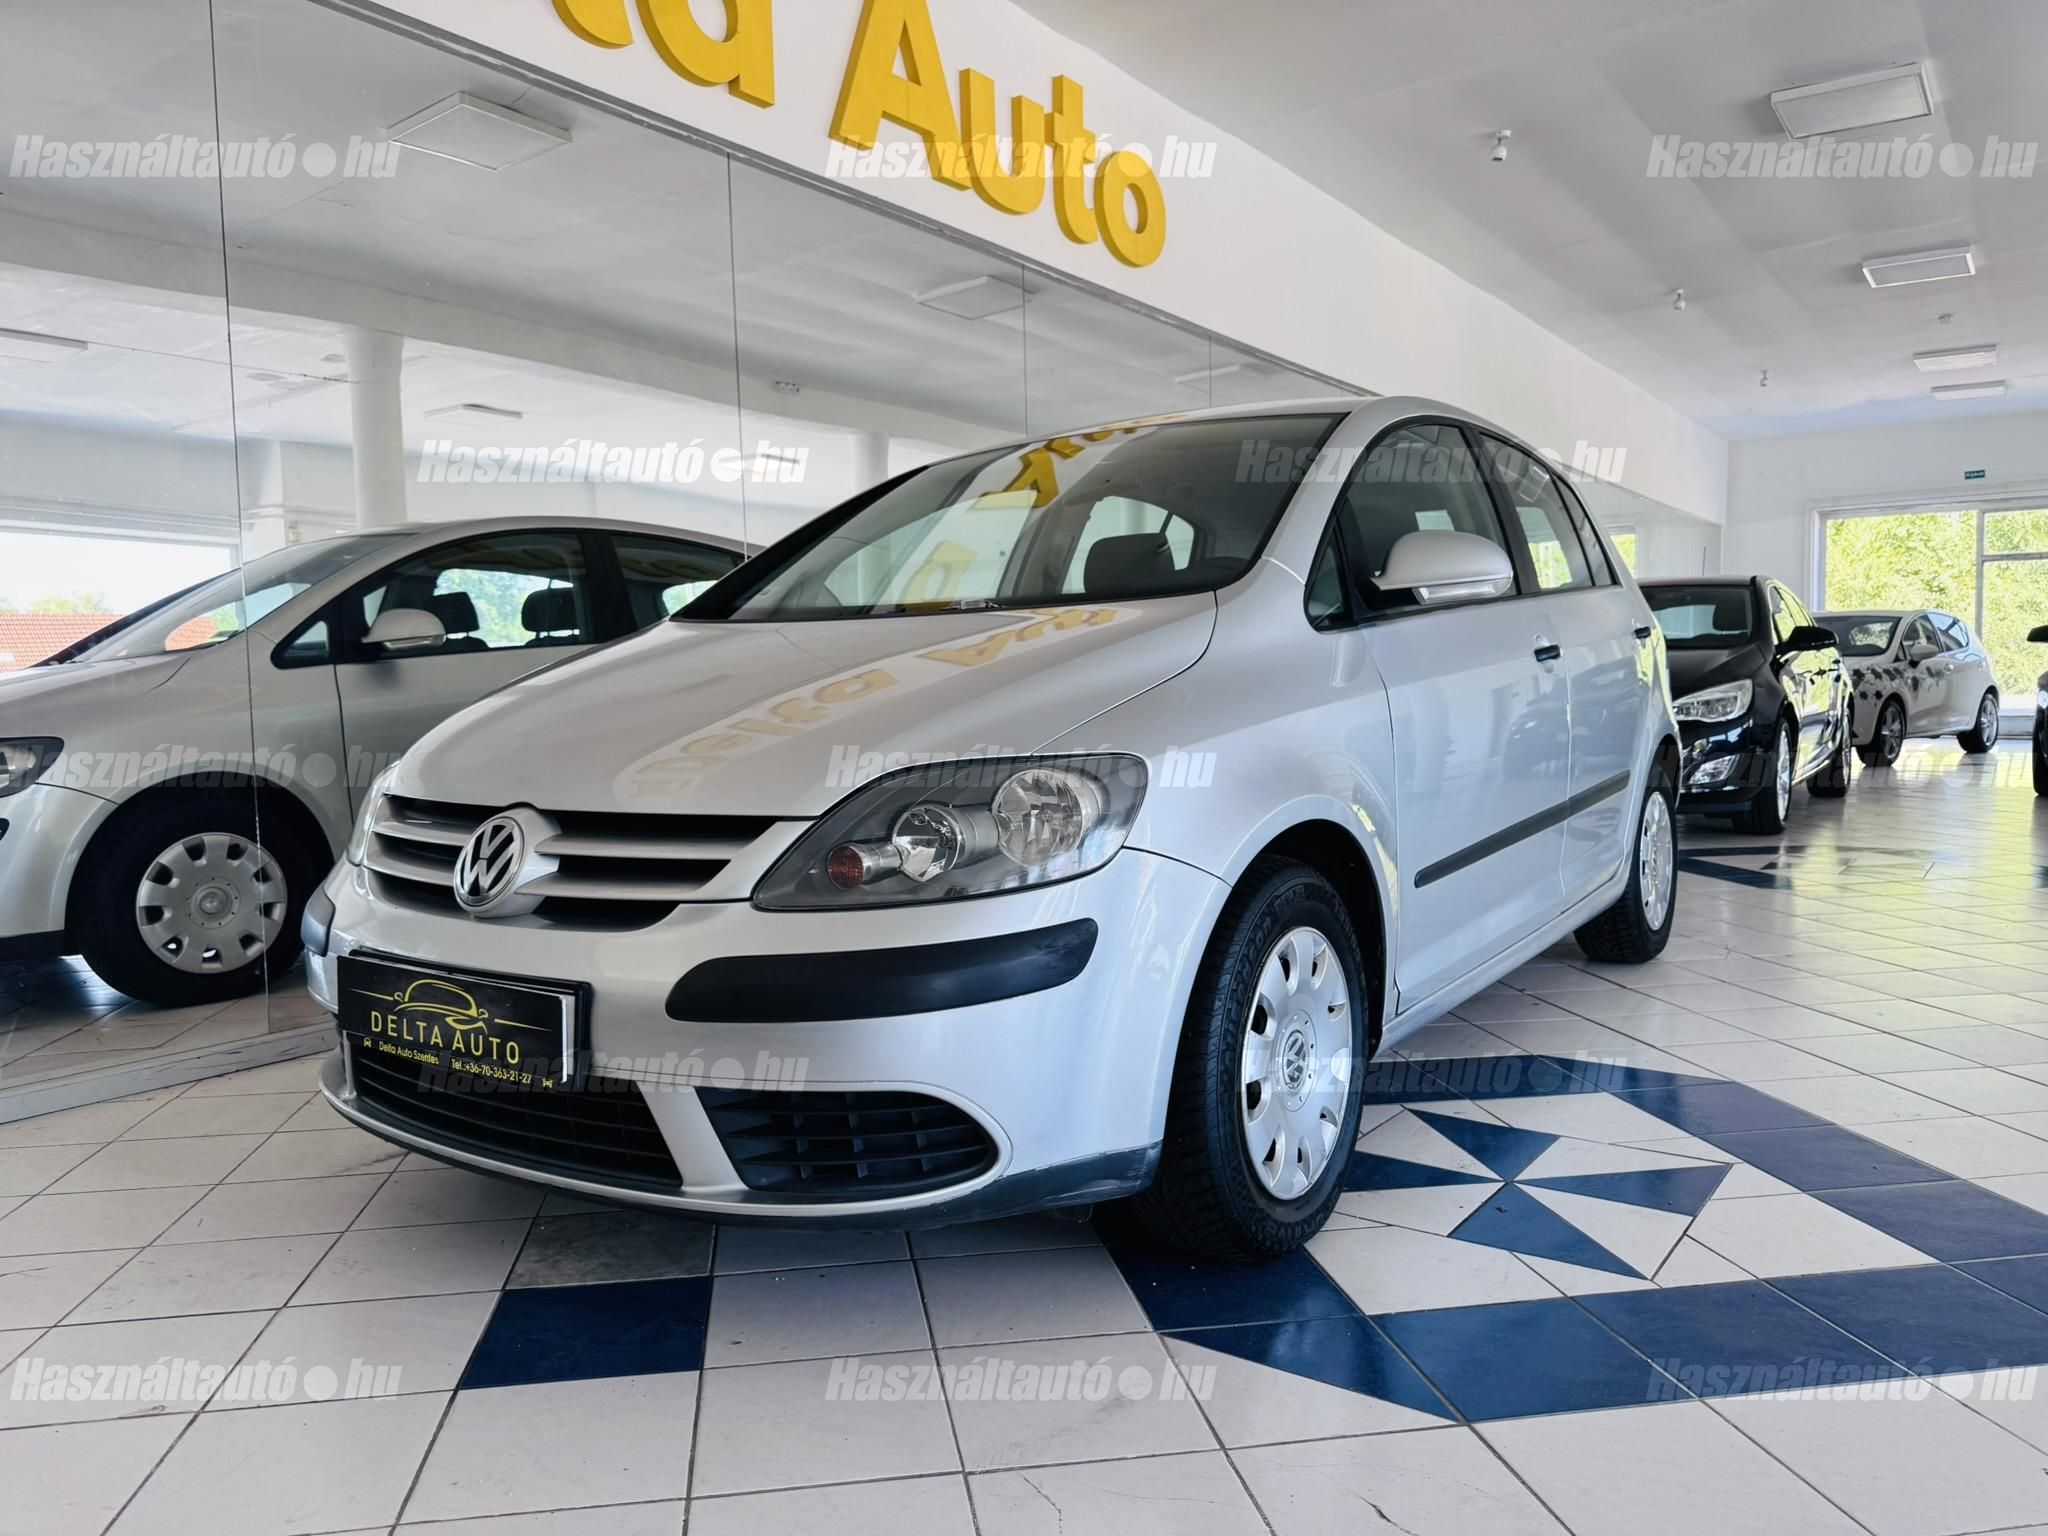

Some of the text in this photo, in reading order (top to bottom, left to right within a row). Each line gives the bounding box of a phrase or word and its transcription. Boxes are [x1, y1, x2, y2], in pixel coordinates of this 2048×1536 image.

[828, 0, 1166, 268] Auto
[370, 1010, 519, 1064] DELTA AUTO
[379, 1040, 396, 1055] Delta
[397, 1046, 413, 1058] Auto
[413, 1050, 440, 1065] Szentes
